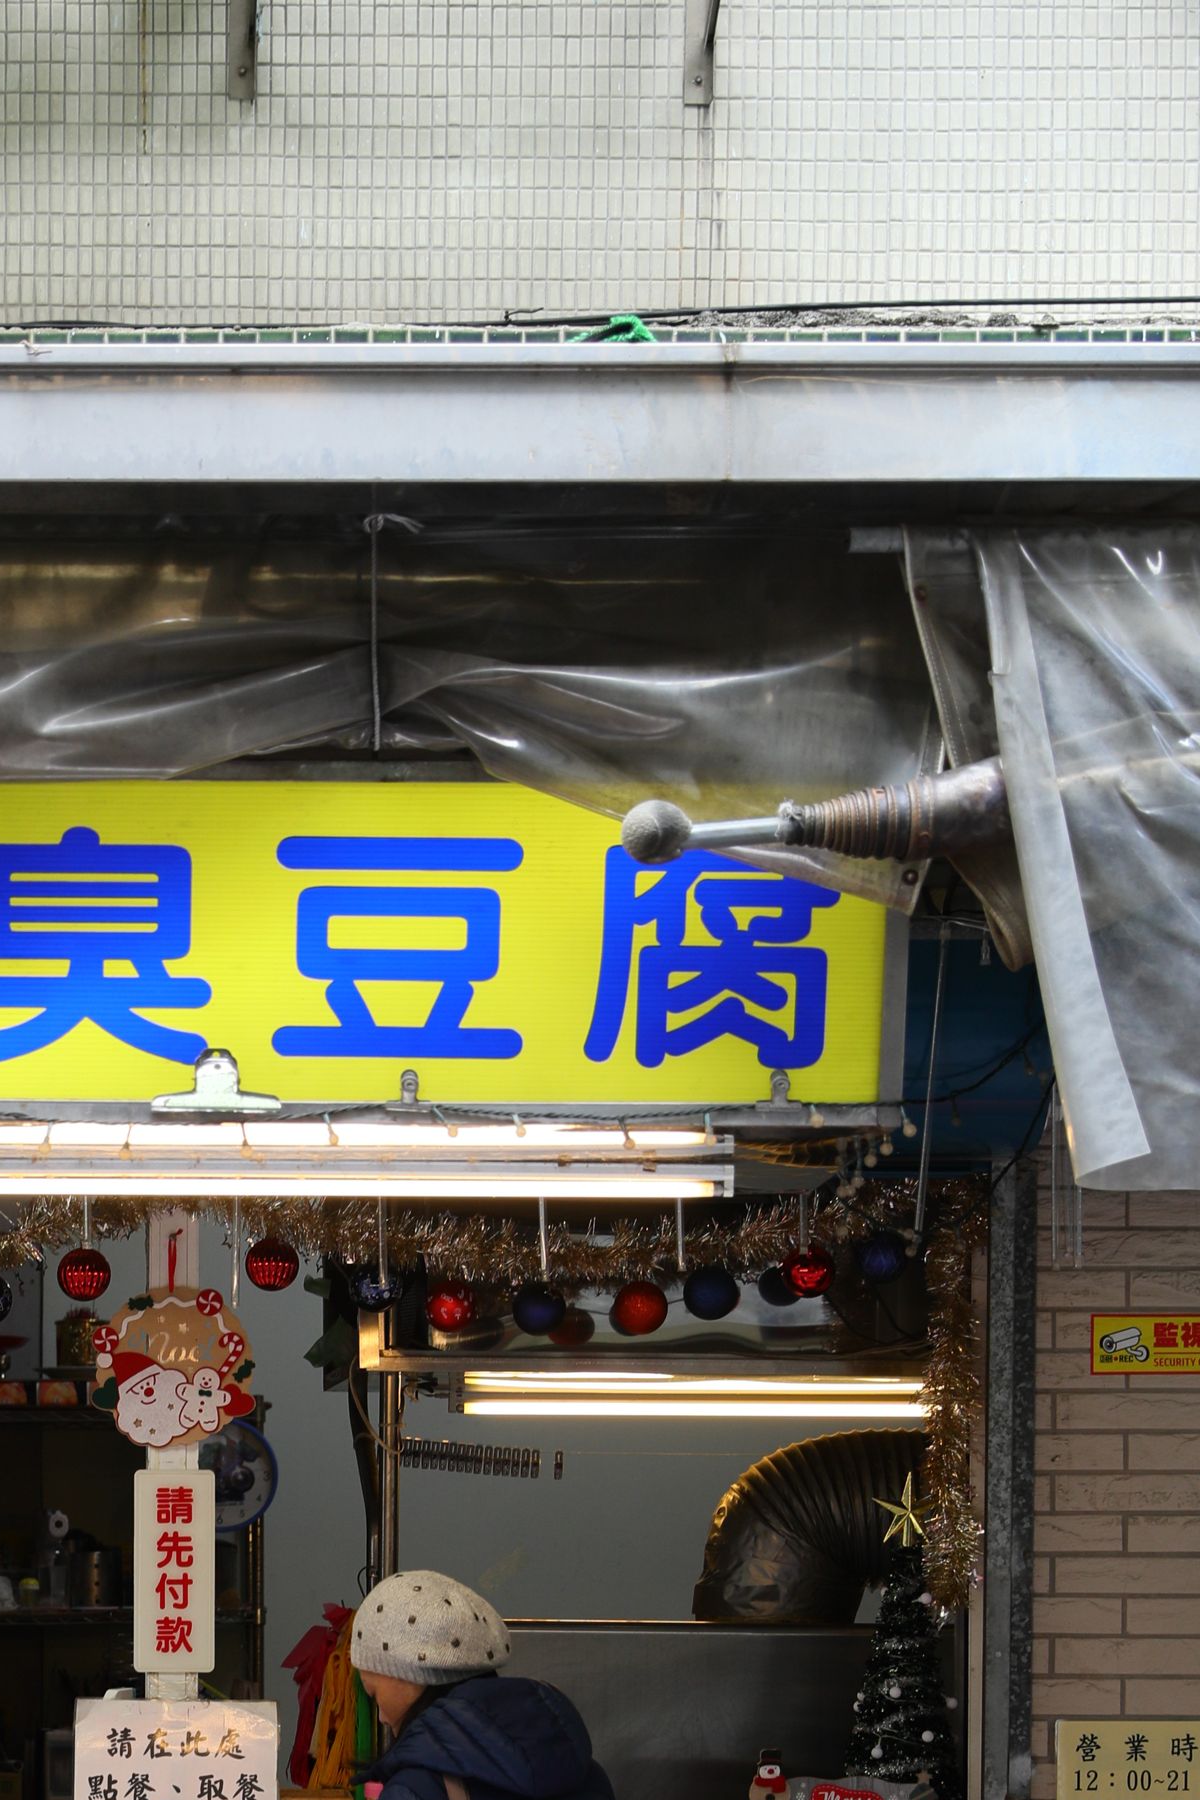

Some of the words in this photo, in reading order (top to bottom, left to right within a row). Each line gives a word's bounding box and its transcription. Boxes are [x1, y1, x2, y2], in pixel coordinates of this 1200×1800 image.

[1153, 1358, 1196, 1367] SECURITY
[155, 1486, 194, 1655] 請先付款
[106, 1727, 246, 1759] 請在此處
[1075, 1733, 1199, 1762] 營業時
